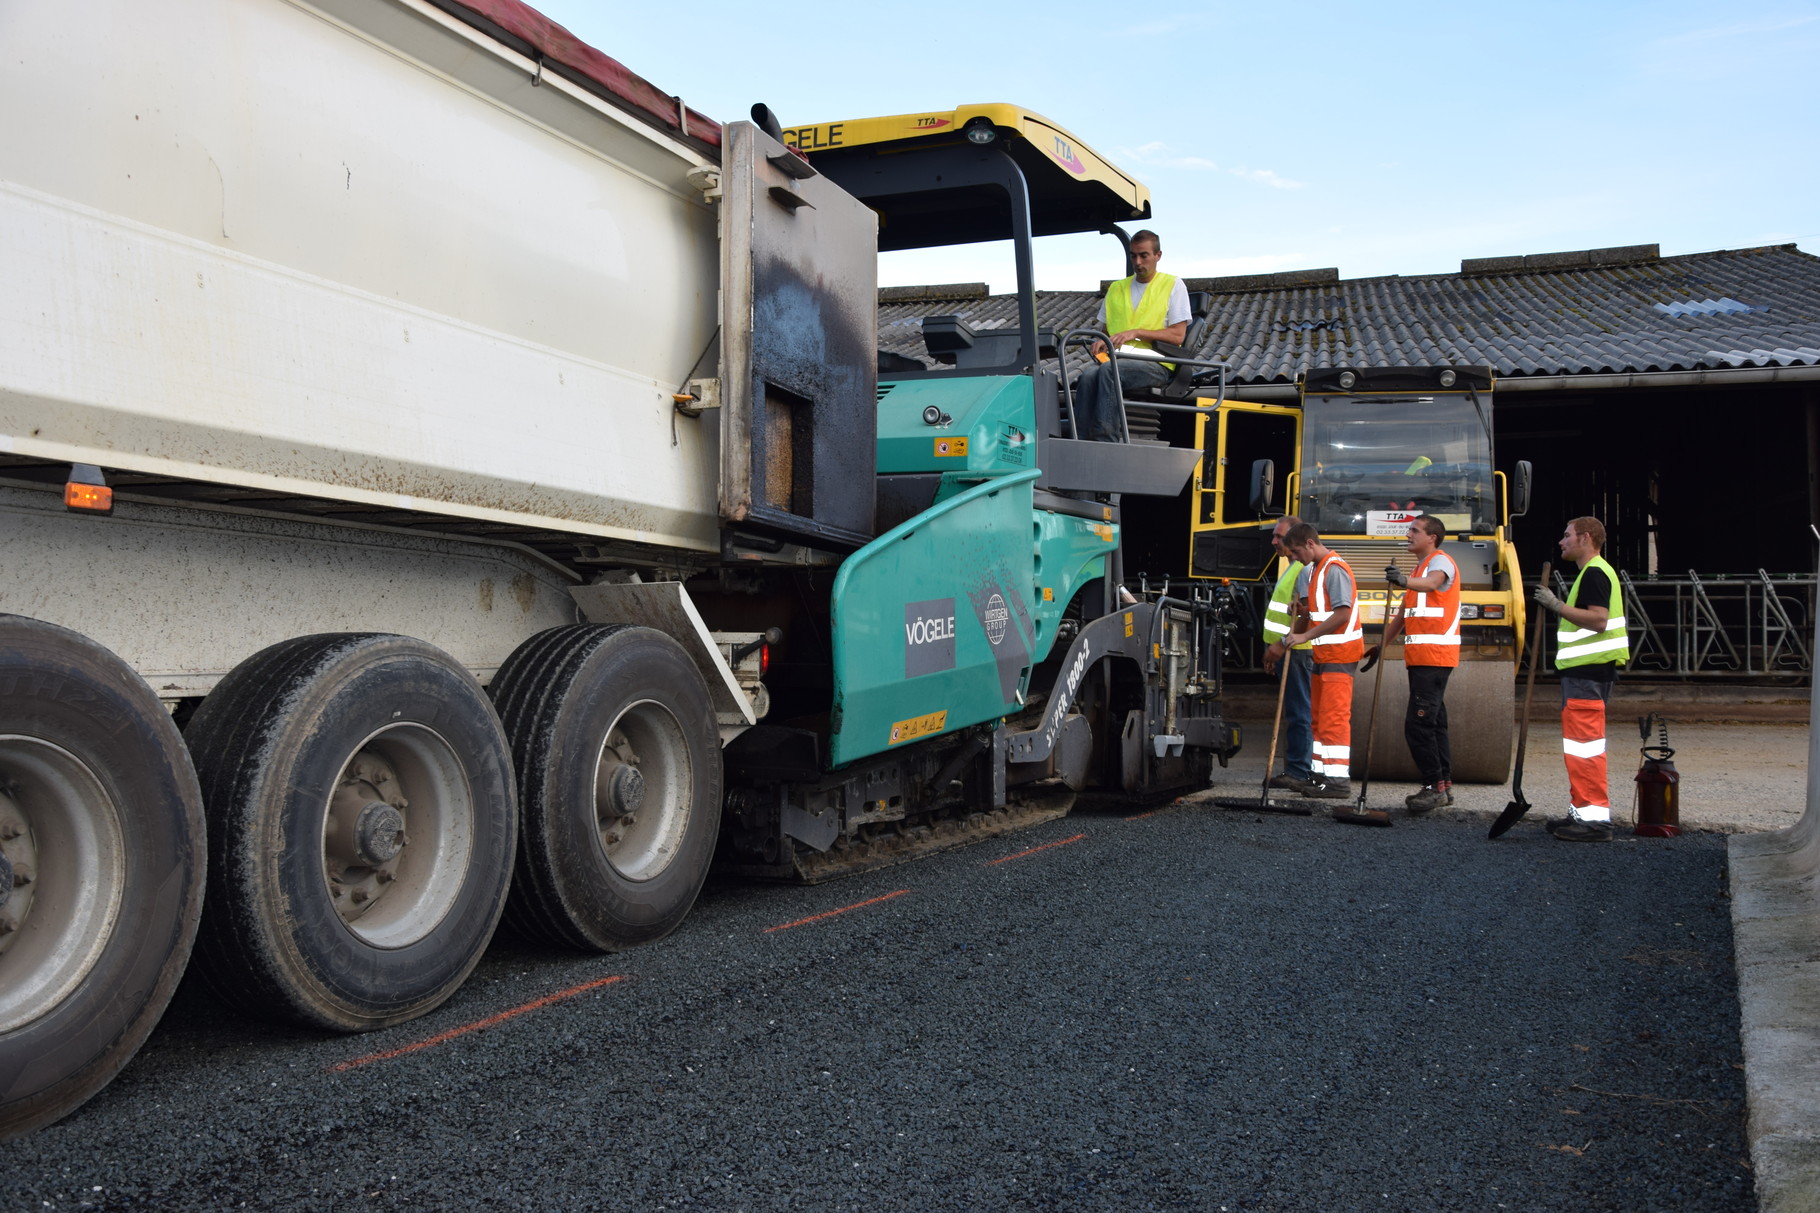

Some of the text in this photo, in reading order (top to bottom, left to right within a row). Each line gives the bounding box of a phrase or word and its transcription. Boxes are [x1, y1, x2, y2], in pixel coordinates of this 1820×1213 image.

[917, 117, 936, 126] TTA
[1054, 135, 1073, 163] TTA
[985, 607, 1008, 620] WIRTGEN
[905, 616, 955, 646] VÖGELE
[986, 620, 1006, 631] GROUP
[1046, 638, 1090, 749] SUPER 1800-2
